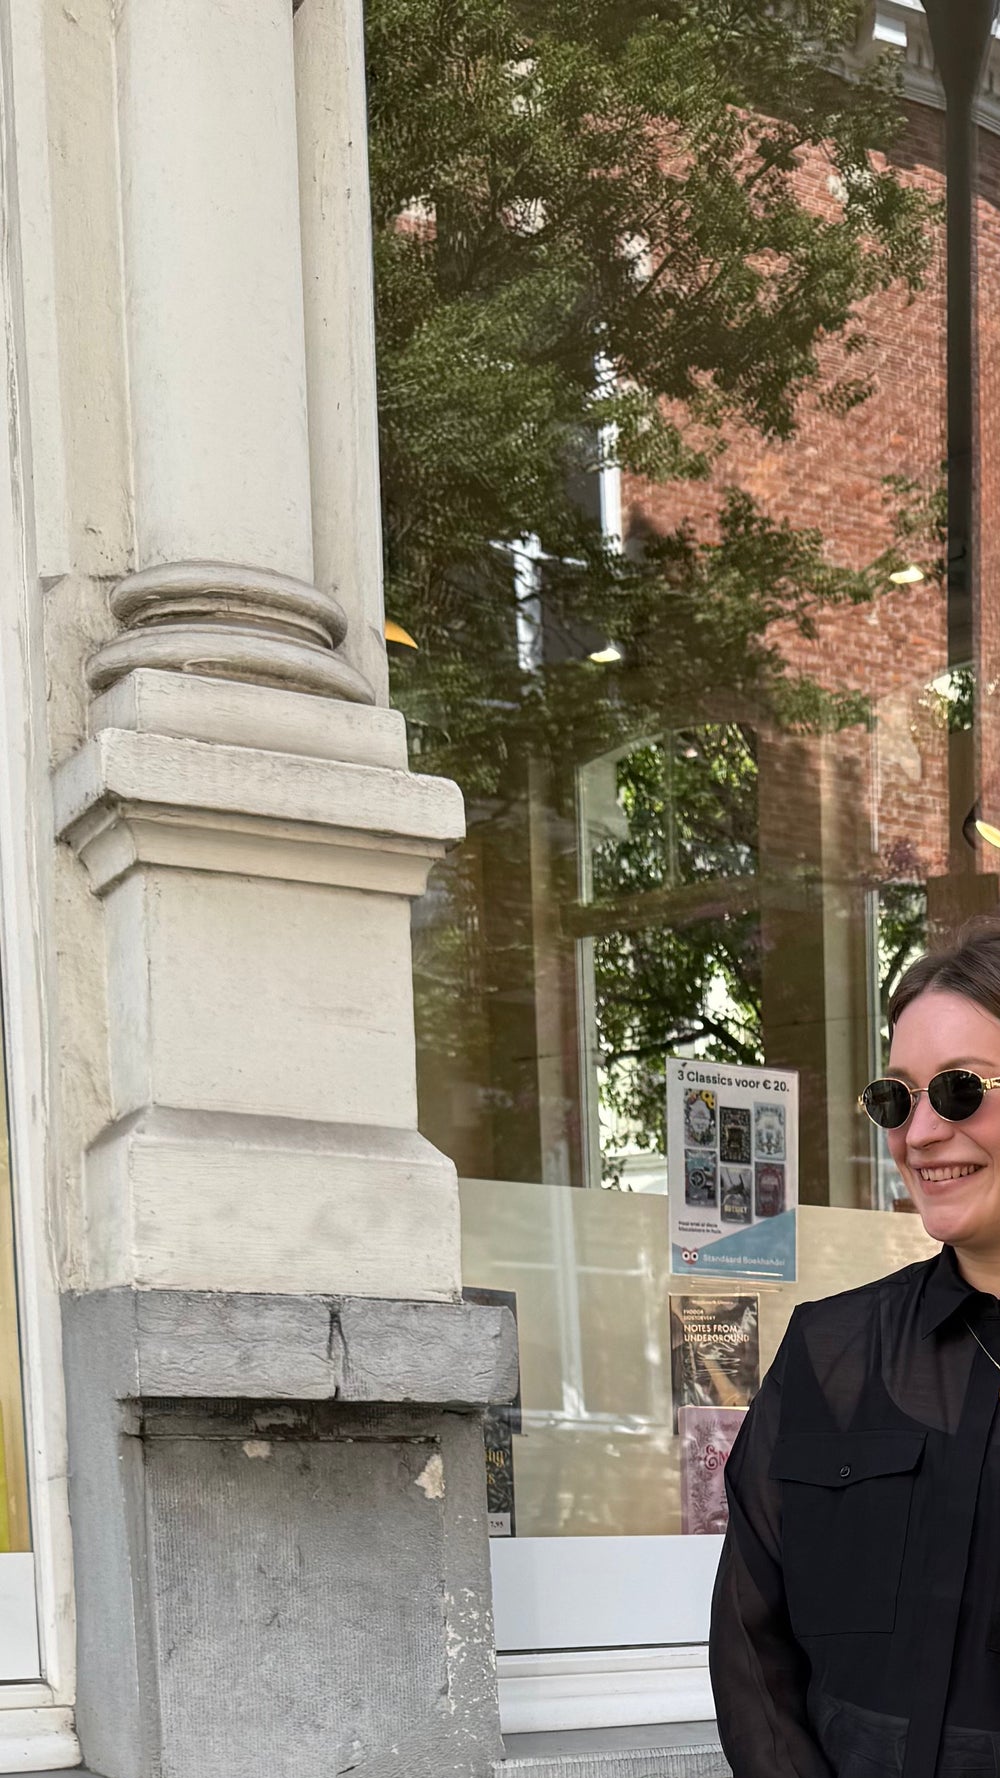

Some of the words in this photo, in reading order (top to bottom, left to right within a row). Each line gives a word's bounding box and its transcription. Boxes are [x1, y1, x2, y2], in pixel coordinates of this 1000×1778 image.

[678, 1070, 685, 1081] 3
[687, 1071, 733, 1086] Classics
[734, 1079, 760, 1089] voor
[762, 1079, 772, 1090] €
[773, 1081, 790, 1092] 20.
[703, 1254, 742, 1264] Standaard
[743, 1257, 786, 1267] Boekhandel
[683, 1324, 712, 1333] NOTES
[713, 1324, 737, 1334] FROM
[683, 1334, 750, 1343] UNDERGROUND
